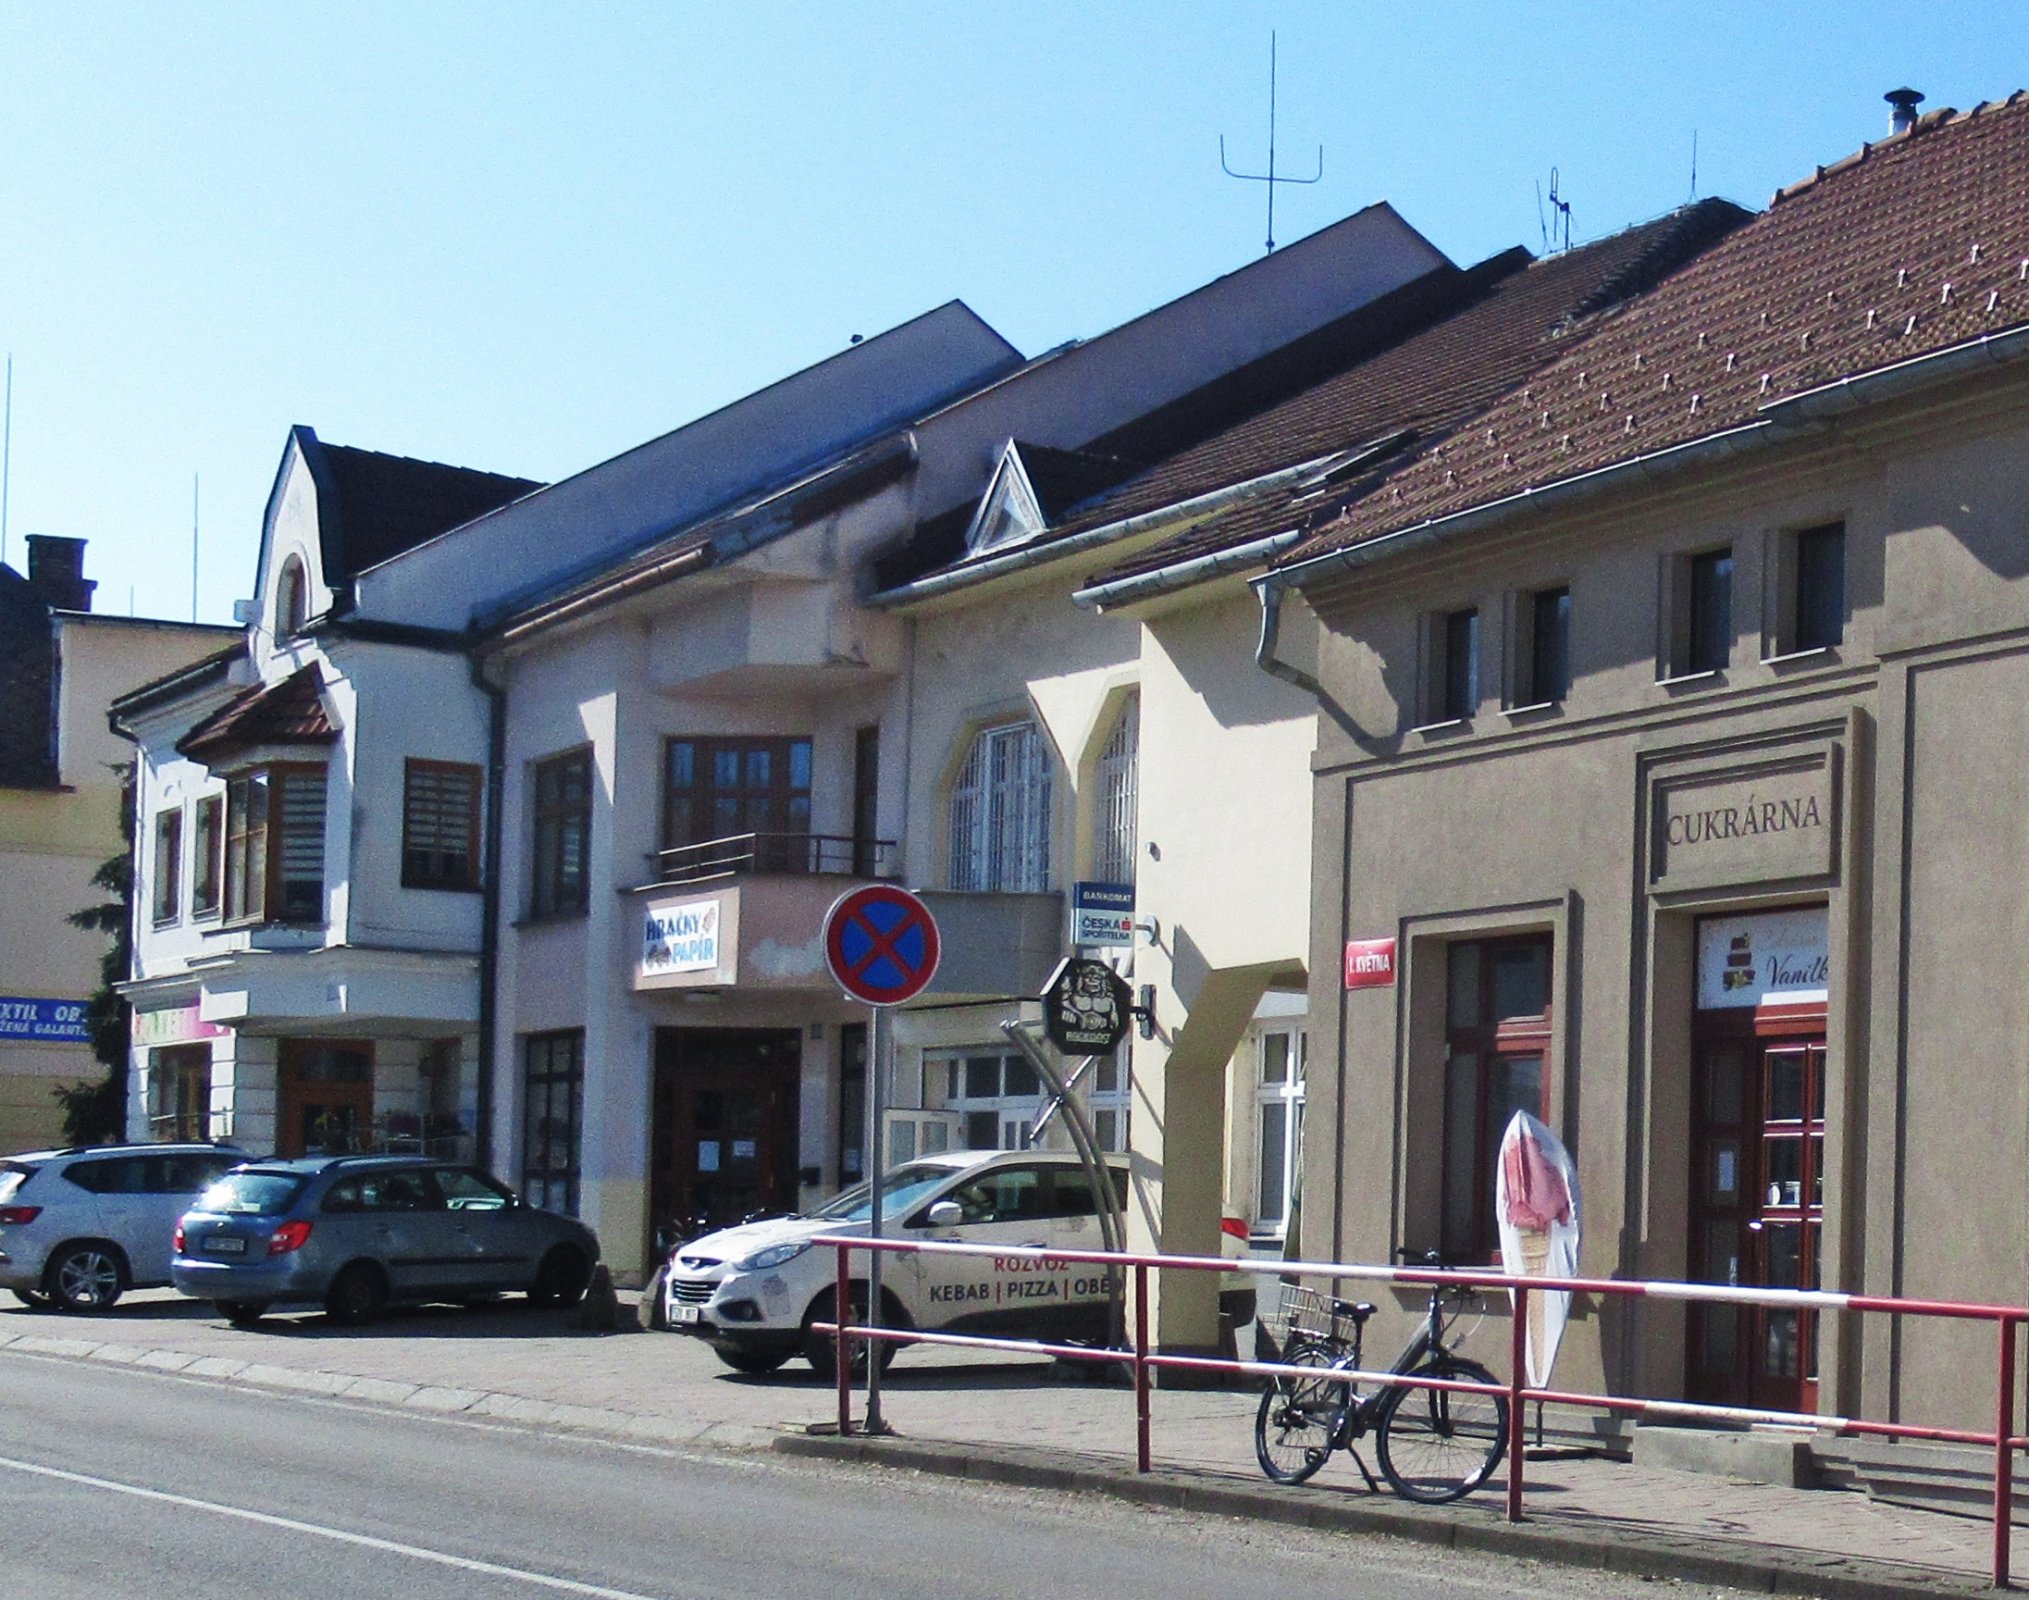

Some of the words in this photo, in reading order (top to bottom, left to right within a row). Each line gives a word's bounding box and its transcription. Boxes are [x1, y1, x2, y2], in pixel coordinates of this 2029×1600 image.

[1668, 794, 1822, 846] CUKRÁRNA
[1083, 891, 1132, 902] BANKOMAT
[646, 909, 701, 941] HRAČKY
[672, 934, 714, 964] PAPÍR
[1356, 950, 1391, 973] KVĚTNA
[994, 1257, 1069, 1272] ROZVOZ
[930, 1284, 990, 1301] KEBAB
[1007, 1279, 1058, 1298] PIZZA
